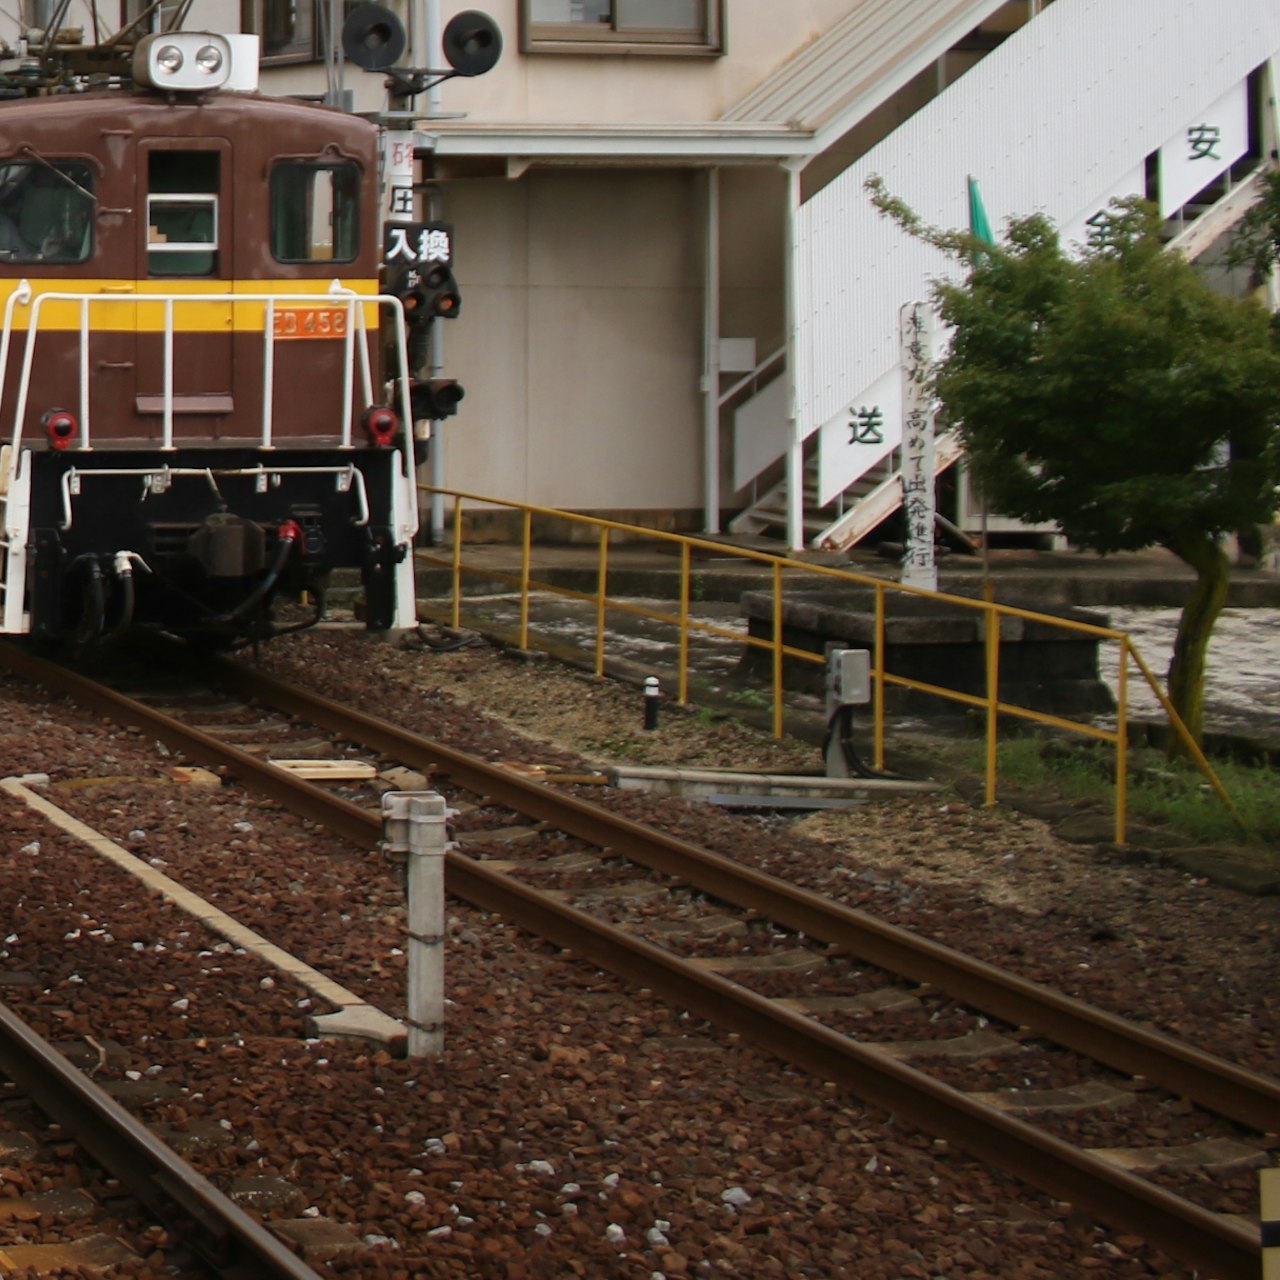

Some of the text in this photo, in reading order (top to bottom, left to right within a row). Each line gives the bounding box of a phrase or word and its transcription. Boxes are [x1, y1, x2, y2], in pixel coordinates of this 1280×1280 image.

[1187, 122, 1221, 160] 安
[386, 228, 450, 261] 入換
[304, 311, 345, 334] 458
[848, 405, 884, 445] 送
